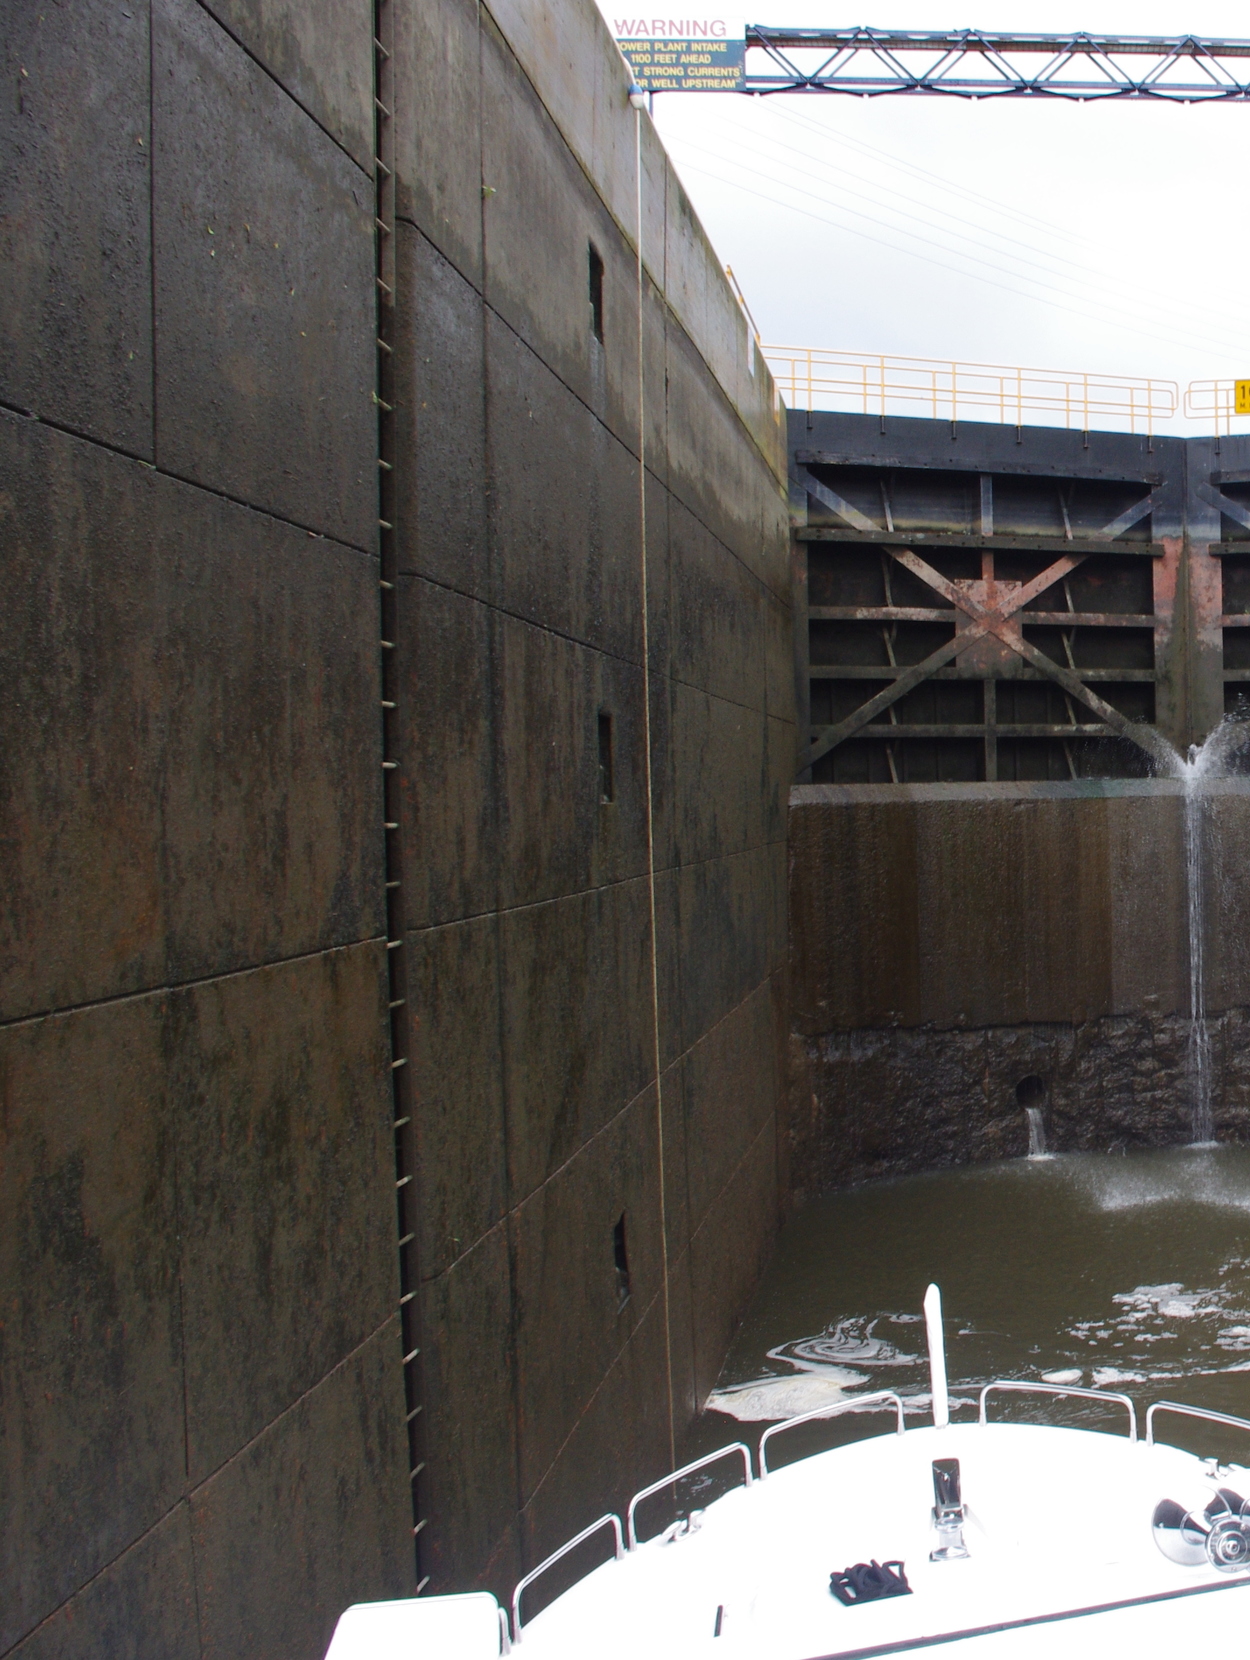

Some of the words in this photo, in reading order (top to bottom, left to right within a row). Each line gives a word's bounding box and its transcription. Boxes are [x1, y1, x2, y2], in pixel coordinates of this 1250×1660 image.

[614, 19, 726, 37] WARNING
[617, 42, 650, 52] OWER
[655, 42, 688, 51] PLANT
[691, 43, 727, 52] INTAKE
[631, 54, 651, 63] 1100
[655, 54, 677, 63] FEET
[680, 54, 711, 63] AHEAD
[644, 67, 684, 76] STRONG
[688, 67, 740, 77] CURRENTS
[652, 79, 678, 88] WELL
[682, 79, 735, 88] UPSTREAM
